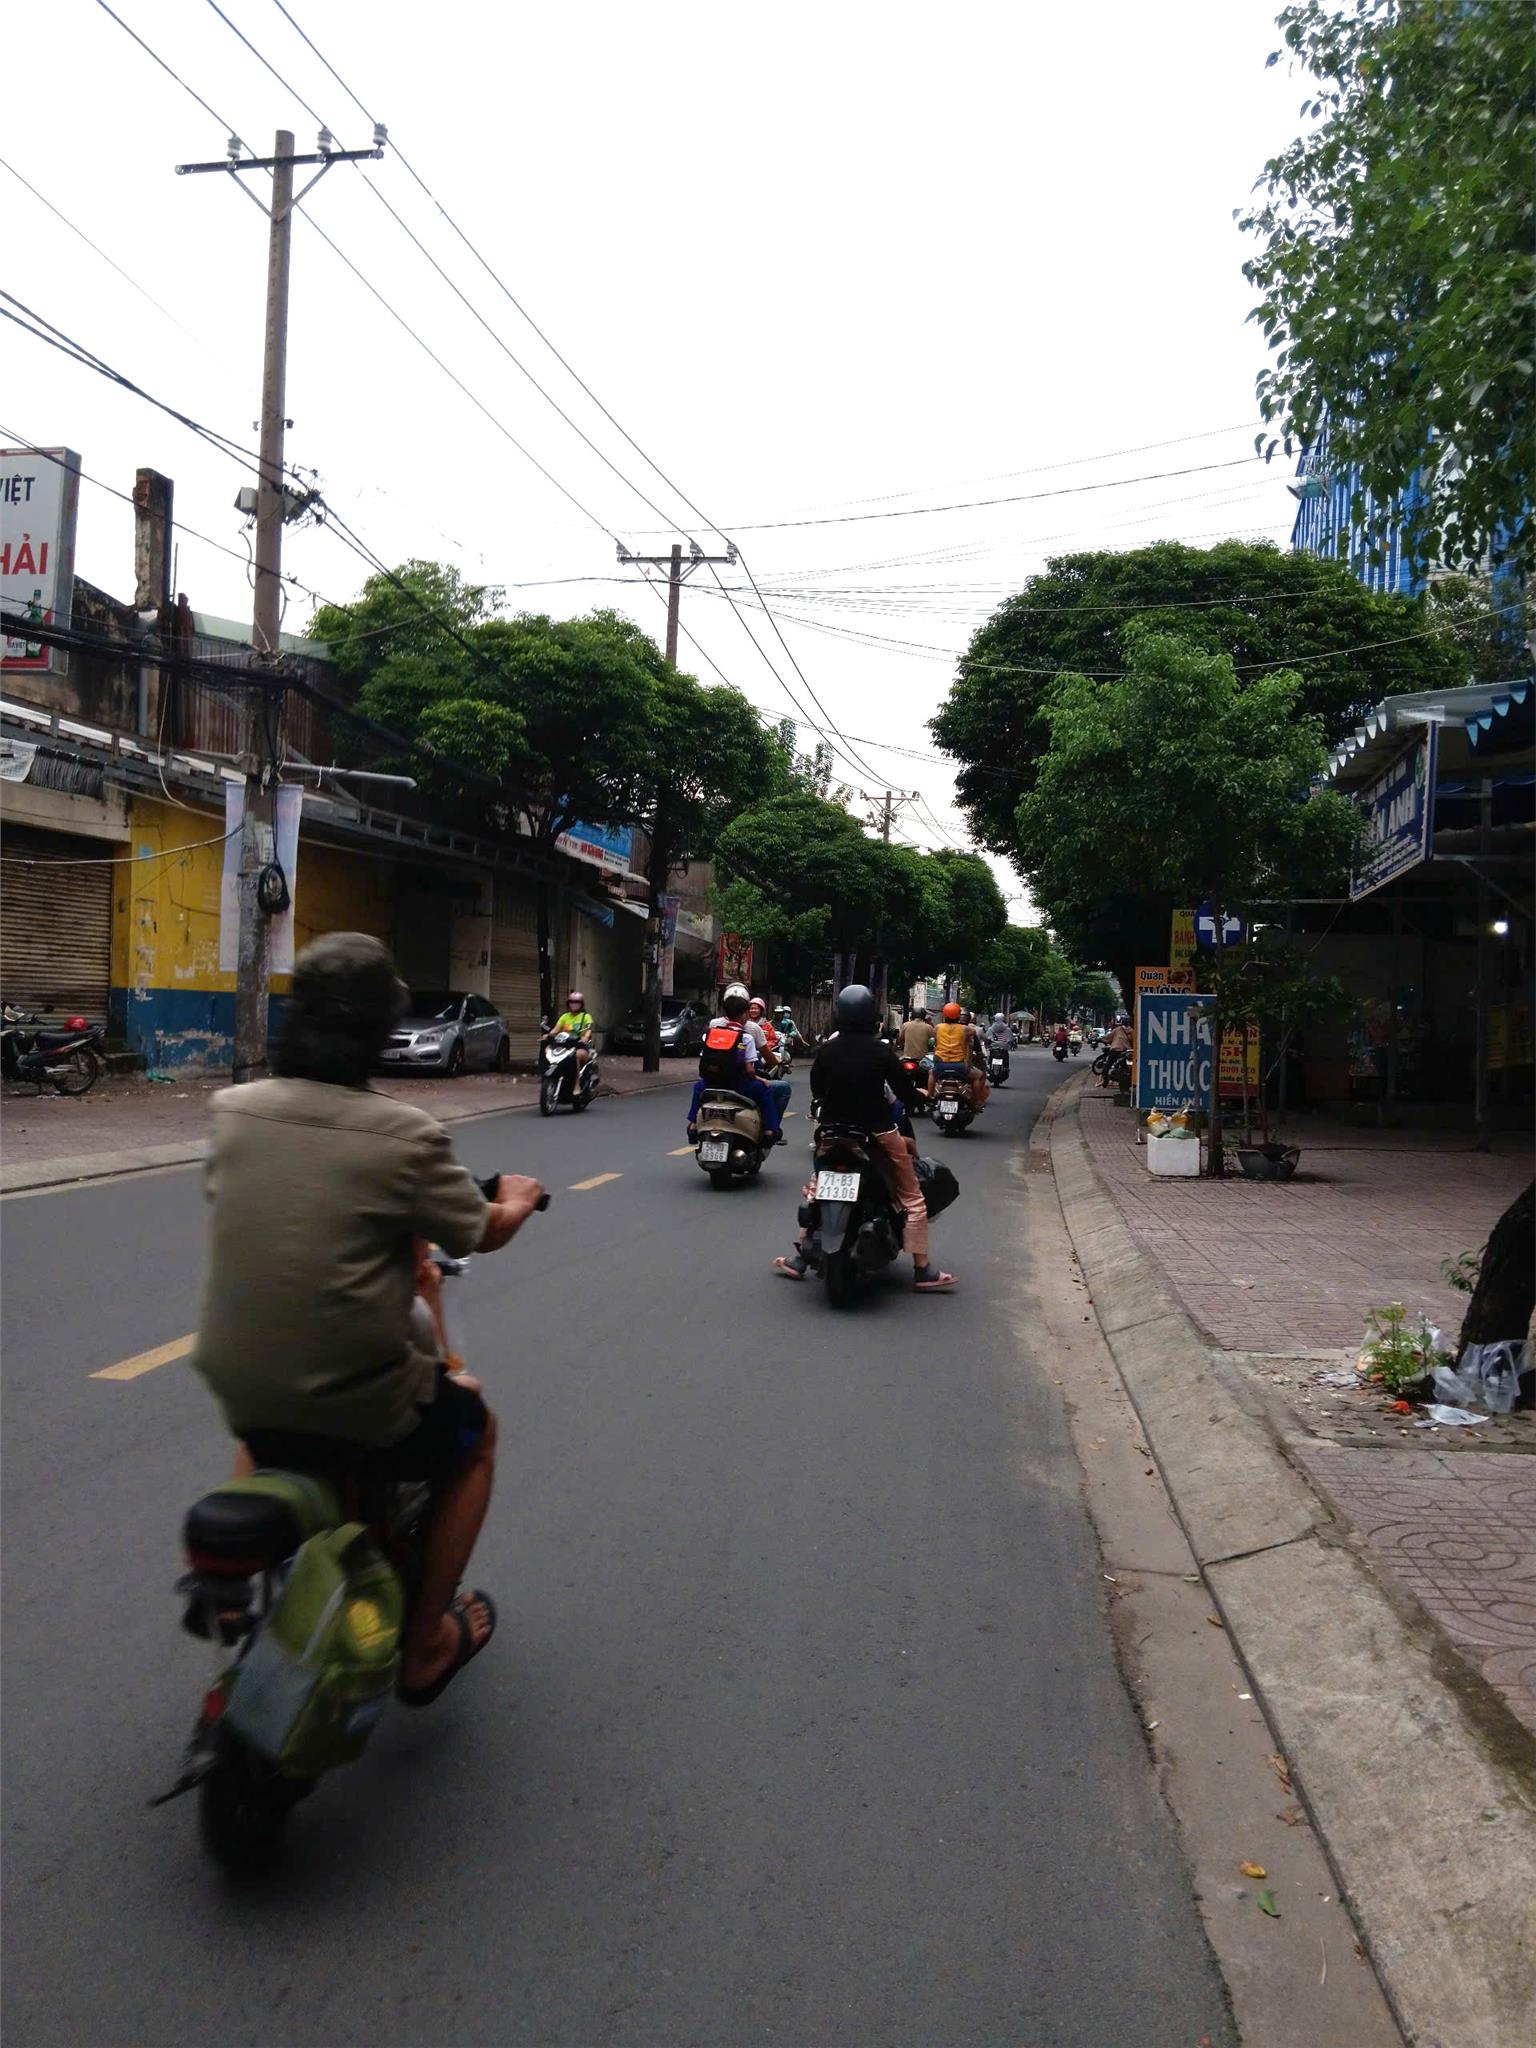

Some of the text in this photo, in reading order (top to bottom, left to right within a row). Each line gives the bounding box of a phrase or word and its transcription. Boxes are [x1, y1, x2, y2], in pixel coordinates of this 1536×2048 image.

[1148, 1001, 1212, 1045] NHÀ
[1147, 1046, 1211, 1092] THUỐC
[818, 1185, 856, 1199] 213.06
[823, 1174, 854, 1187] 71-B3
